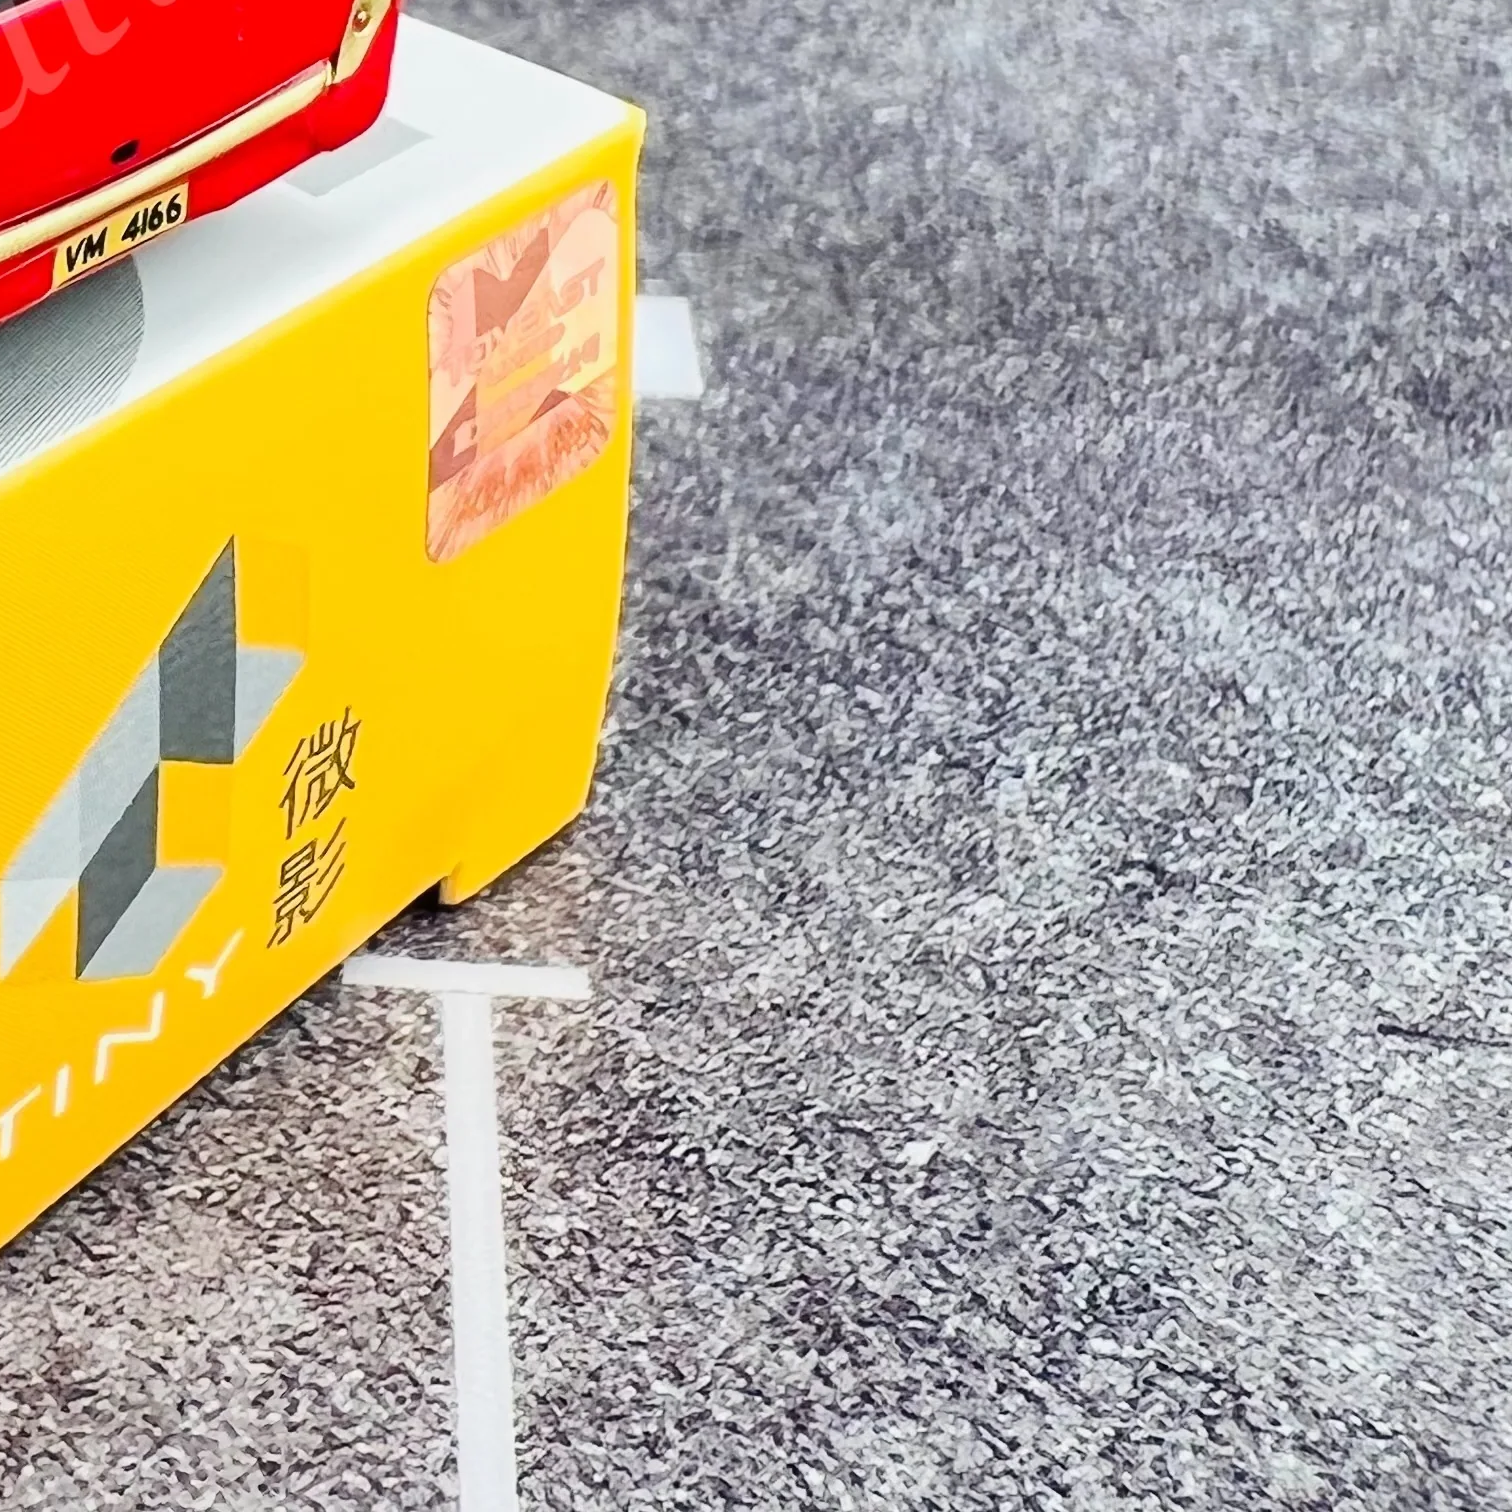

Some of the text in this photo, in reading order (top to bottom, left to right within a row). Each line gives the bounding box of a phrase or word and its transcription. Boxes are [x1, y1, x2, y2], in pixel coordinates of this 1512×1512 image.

[66, 192, 182, 273] VM 4166
[266, 704, 362, 949] 微影
